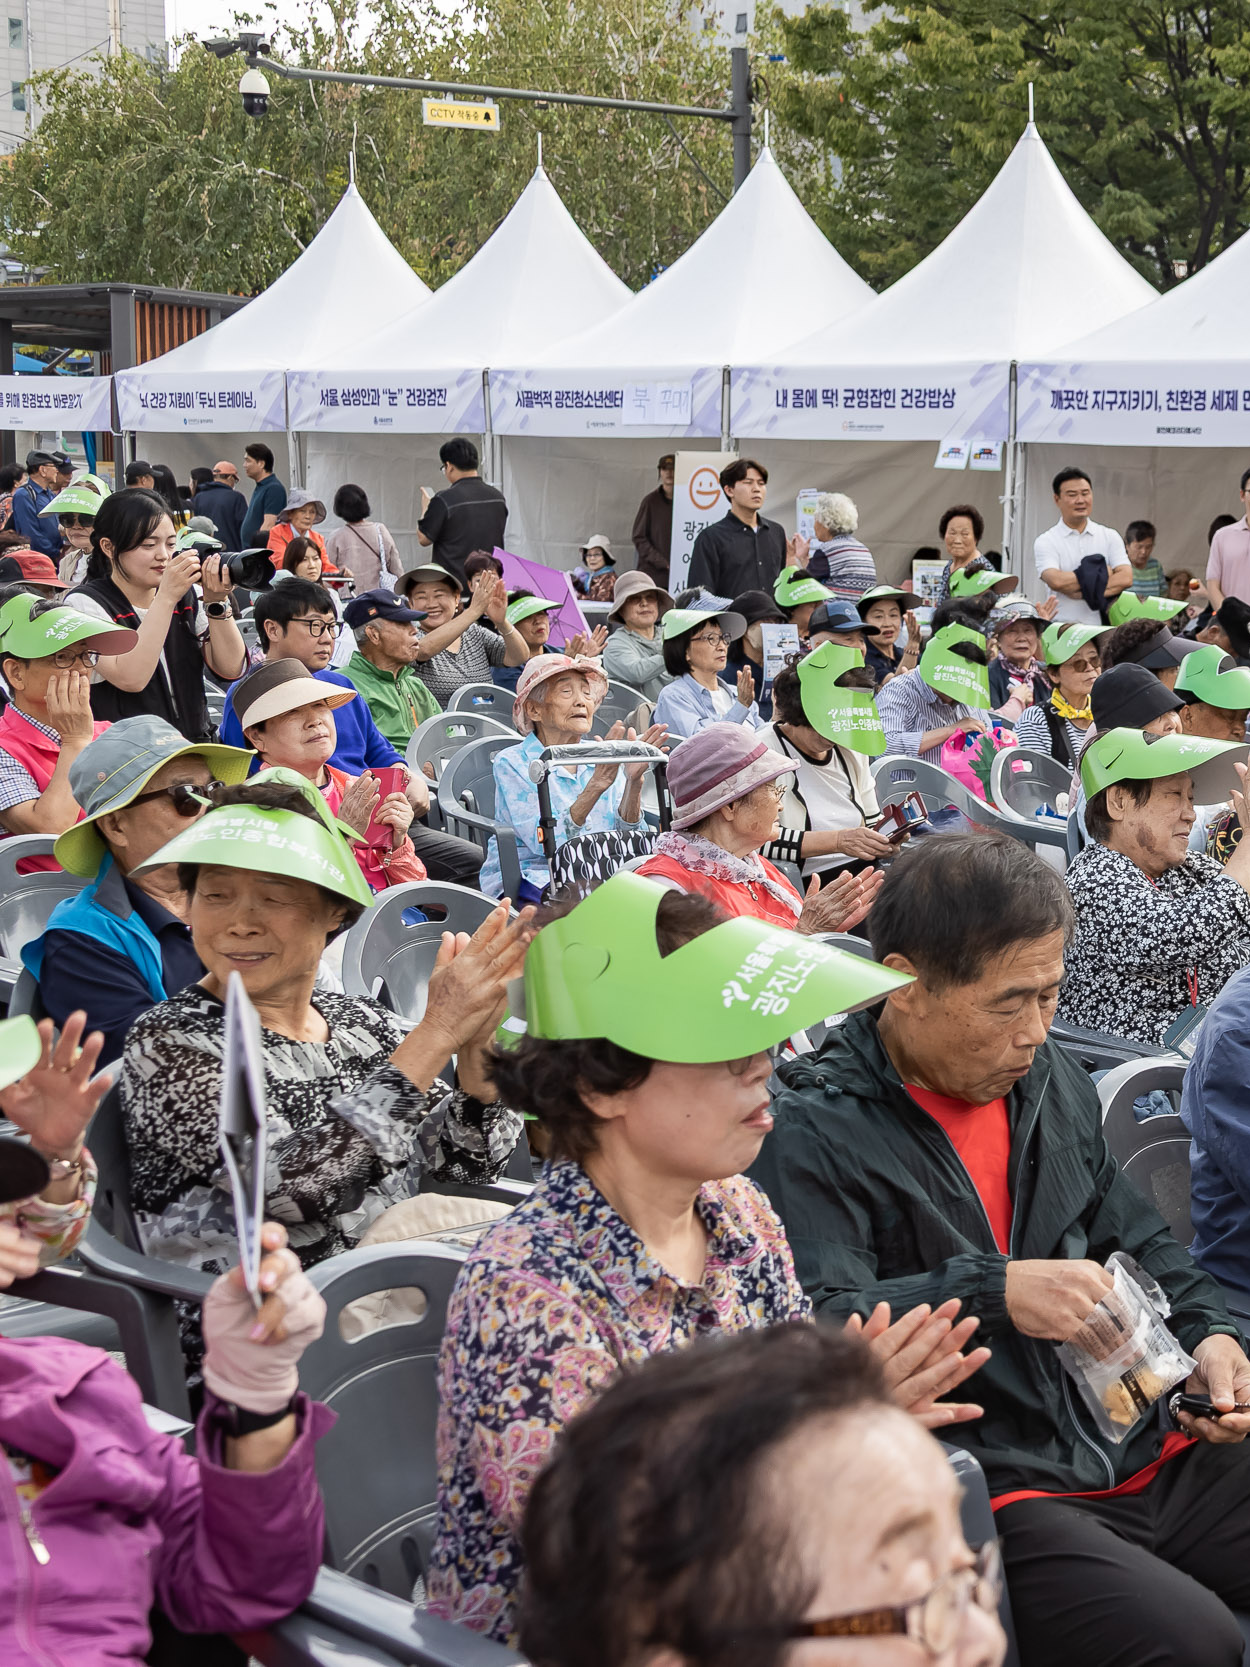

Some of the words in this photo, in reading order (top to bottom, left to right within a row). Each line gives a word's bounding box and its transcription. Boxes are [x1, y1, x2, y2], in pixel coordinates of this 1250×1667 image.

[430, 107, 455, 119] CCTV
[22, 392, 52, 409] 환경보호
[53, 393, 83, 409] 바로알기
[150, 392, 168, 409] 건강
[168, 391, 195, 409] 지킴이
[320, 388, 340, 407] 서울
[341, 387, 381, 407] 삼성안과
[405, 387, 447, 407] 건강검진
[515, 390, 553, 409] 시끌벅적
[554, 390, 624, 409] 광진청소년센터
[775, 388, 788, 409] 내
[792, 388, 818, 409] 몸에
[821, 387, 839, 409] 딱!
[843, 387, 896, 409] 균형잡힌
[900, 387, 956, 409] 건강밥상
[1050, 389, 1089, 411] 깨끗한
[1091, 389, 1162, 413] 지구지키기,
[1166, 389, 1207, 411] 친환경
[1210, 388, 1238, 412] 세제
